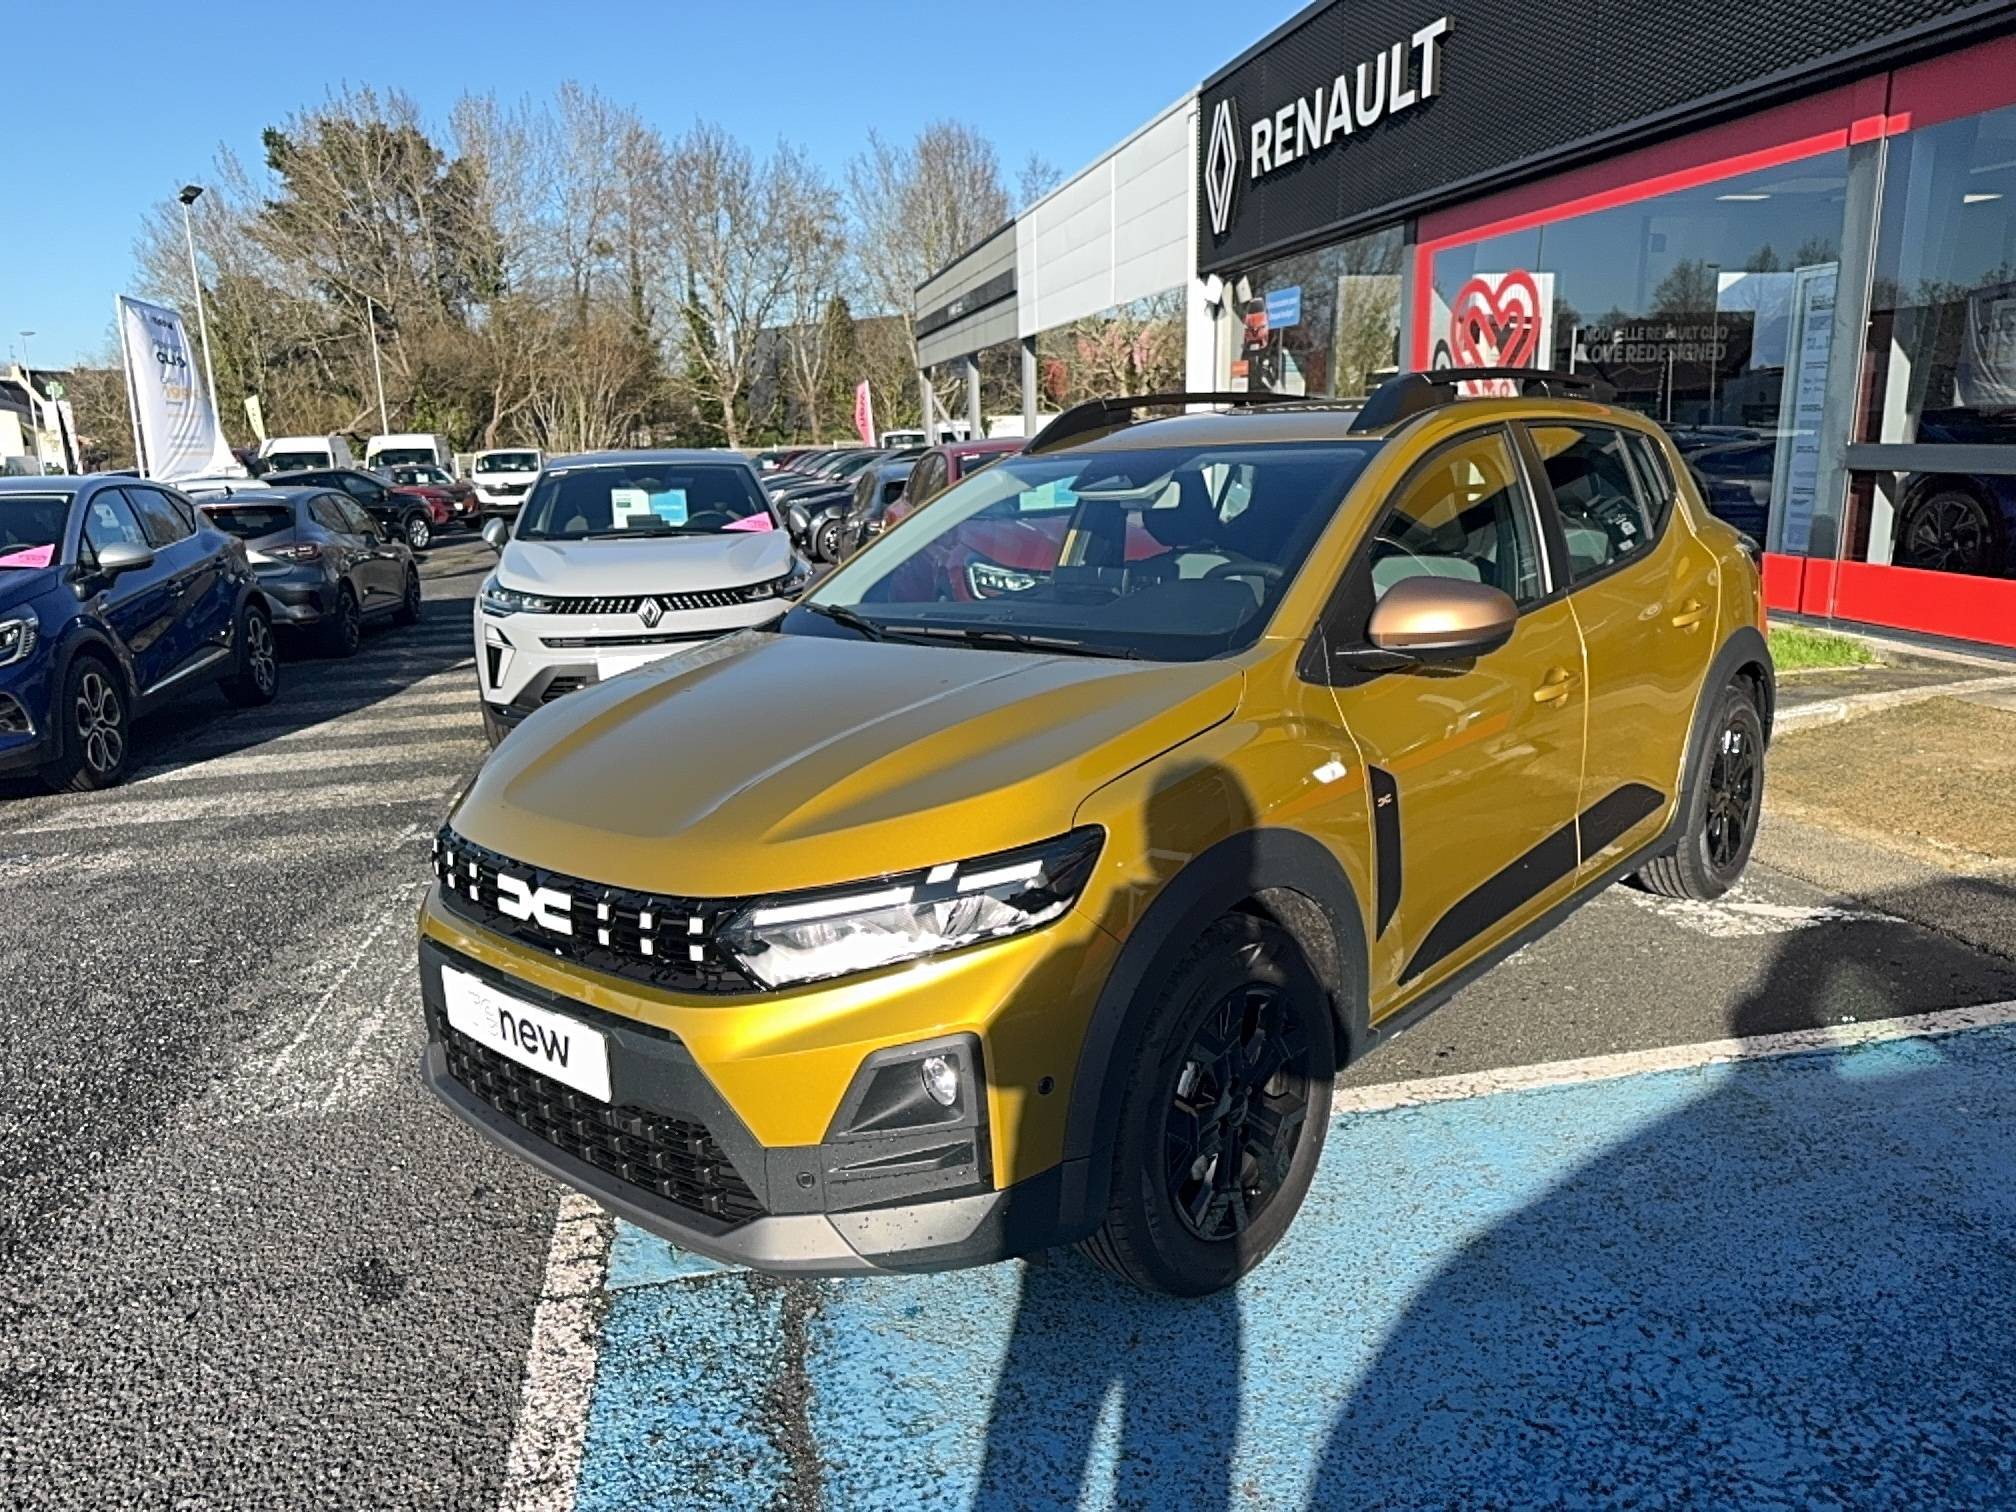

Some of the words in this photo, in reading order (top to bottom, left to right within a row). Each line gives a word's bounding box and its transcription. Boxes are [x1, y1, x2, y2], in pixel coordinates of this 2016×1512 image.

[1251, 16, 1450, 178] RENAULT
[1584, 327, 1644, 342] NOUVELLE
[1646, 327, 1699, 341] RENAULT
[1700, 326, 1728, 340] CLIO
[1625, 343, 1728, 363] REDESIGNED
[499, 1006, 570, 1067] new
